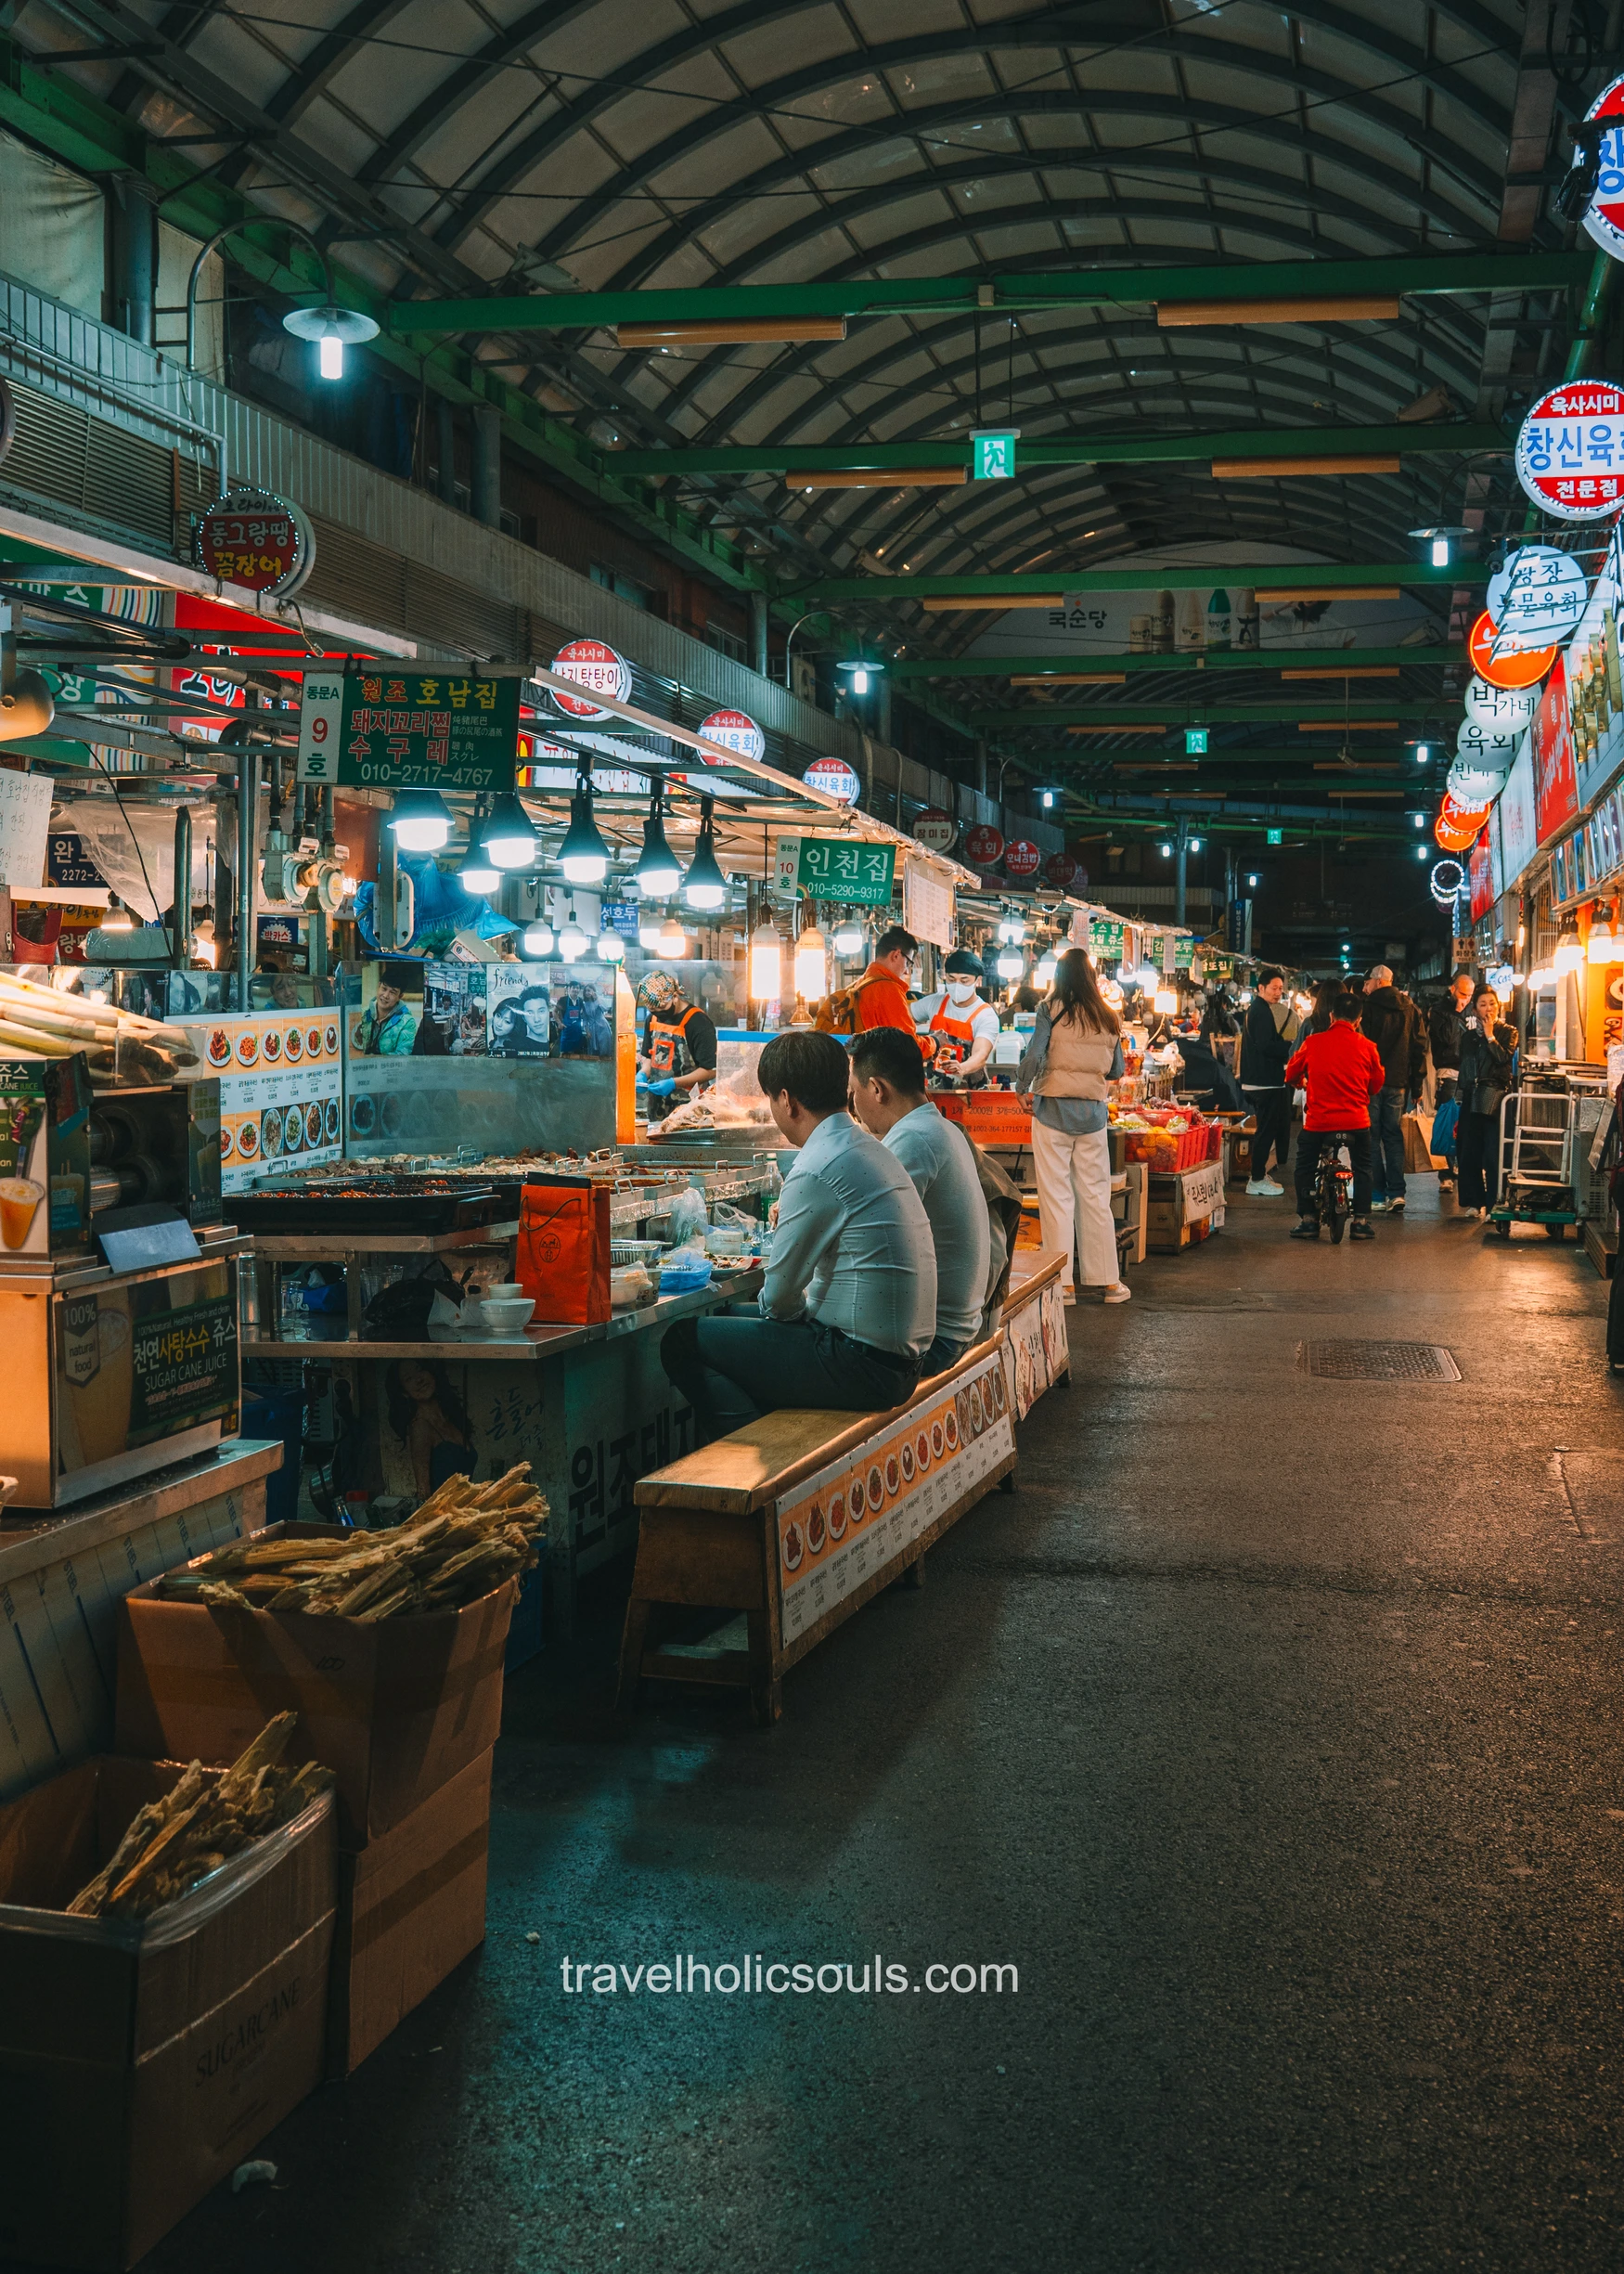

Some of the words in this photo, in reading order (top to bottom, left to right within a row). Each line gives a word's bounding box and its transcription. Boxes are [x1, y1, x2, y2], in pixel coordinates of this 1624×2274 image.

[1551, 394, 1619, 416] 육사시미
[1556, 479, 1618, 499] 전문점
[208, 521, 290, 548] 동그랑땡
[213, 551, 282, 577] 꼼장어
[1049, 608, 1107, 629] 국순당
[567, 648, 606, 661] 육사시미
[306, 686, 340, 700] 동문A
[362, 678, 408, 704] 원조
[416, 678, 497, 710] 호남집
[312, 717, 329, 743] 9
[351, 708, 451, 738] 돼지꼬리찜
[713, 717, 745, 728] 육사시미
[348, 736, 449, 766] 수구레
[304, 753, 328, 777] 호
[361, 763, 494, 786] 010-2717-4767
[917, 828, 949, 839] 장미집
[780, 844, 799, 852] 동문A
[780, 862, 794, 873] 10
[806, 846, 889, 883] 인천집
[779, 876, 792, 889] 호
[807, 882, 884, 899] 010-5290-9317
[264, 931, 289, 941] 박카스
[488, 968, 529, 993] friends
[64, 1303, 97, 1327] 100%
[69, 1342, 96, 1357] natural
[134, 1324, 211, 1375] 천연사탕수수
[213, 1316, 237, 1348] 쥬스
[74, 1360, 92, 1374] food
[145, 1370, 176, 1392] SUGAR
[178, 1363, 202, 1381] CANE
[203, 1352, 227, 1375] JUICE
[196, 1976, 301, 2087] SUGARCANE
